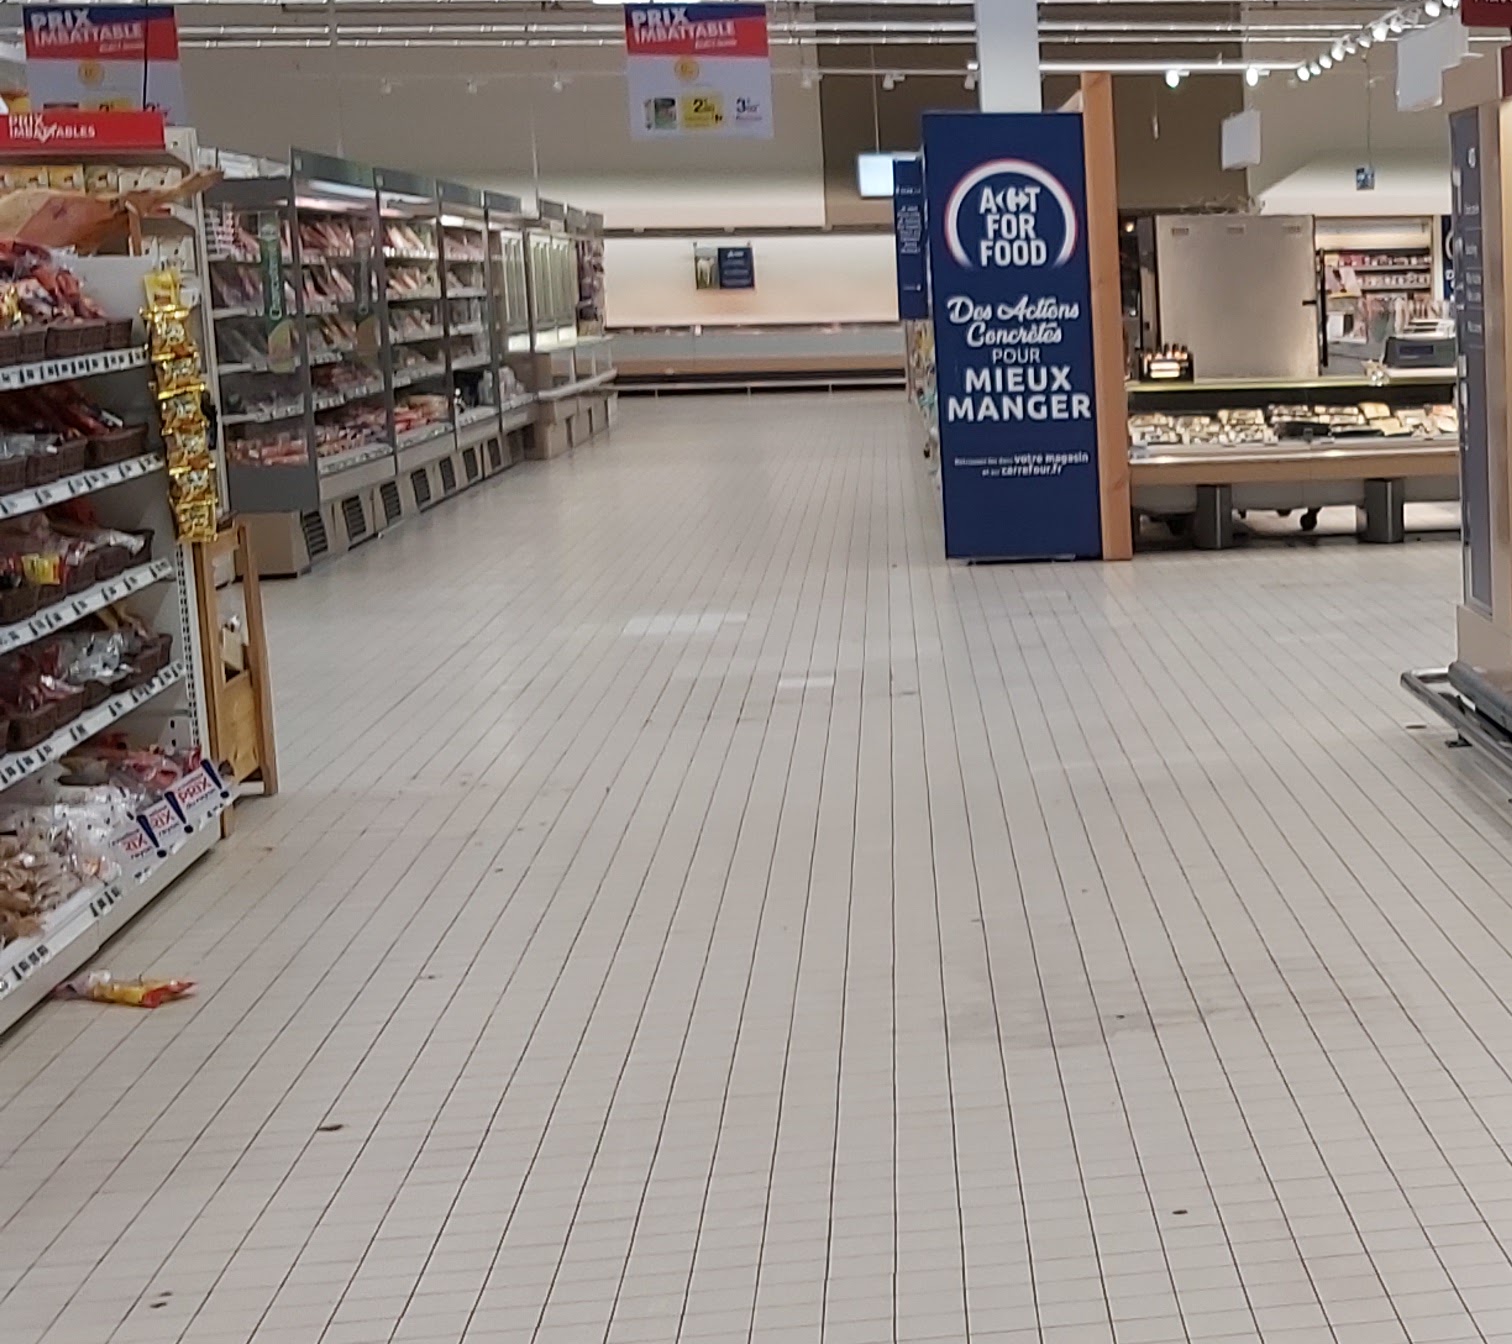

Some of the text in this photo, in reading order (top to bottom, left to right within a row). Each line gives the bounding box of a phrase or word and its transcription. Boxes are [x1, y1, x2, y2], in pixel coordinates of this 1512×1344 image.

[30, 8, 93, 32] PRIX
[631, 7, 690, 29] PRIX
[33, 22, 142, 47] IMBATTABLE
[634, 20, 736, 44] IMBATTABLE
[9, 112, 44, 129] PRIX
[10, 120, 96, 143] IMBATTABLES
[987, 214, 1036, 239] FOR
[980, 241, 1047, 267] FOOD
[948, 296, 1080, 324] Des Actions
[966, 320, 1063, 348] Concrètes
[992, 348, 1041, 365] POUR
[965, 366, 1072, 392] MIEUX
[948, 394, 1092, 422] MANGER
